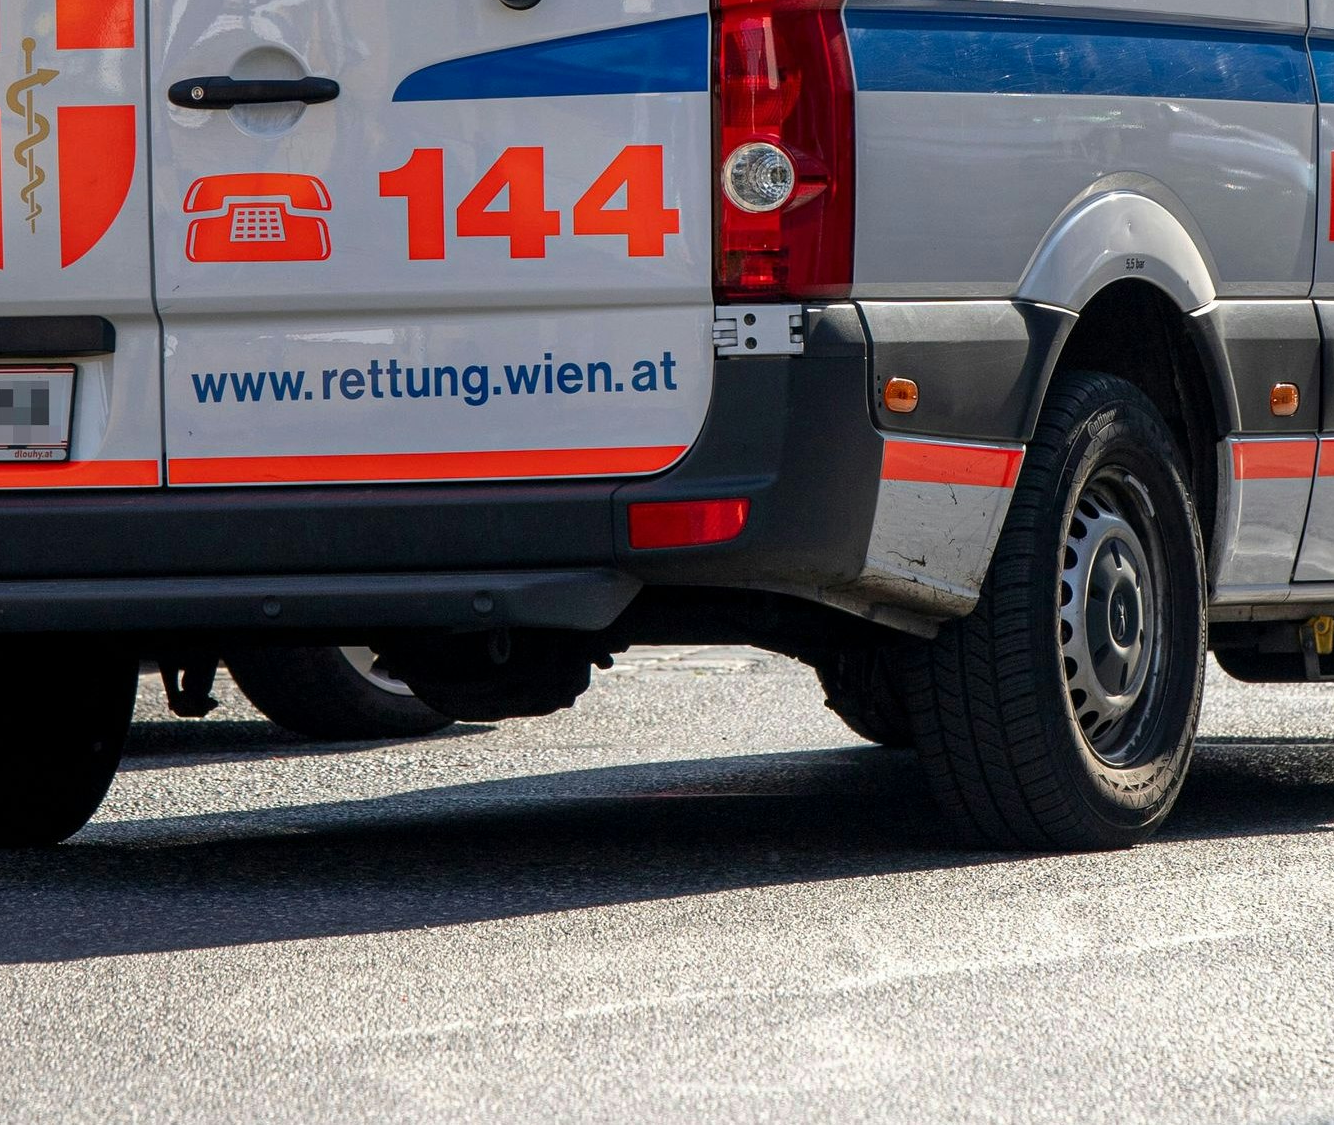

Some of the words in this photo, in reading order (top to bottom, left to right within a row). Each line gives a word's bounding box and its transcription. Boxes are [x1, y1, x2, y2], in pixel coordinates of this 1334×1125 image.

[379, 145, 680, 260] 144
[191, 351, 677, 406] www.rettung.wien.at
[14, 449, 53, 459] dlouhy.at
